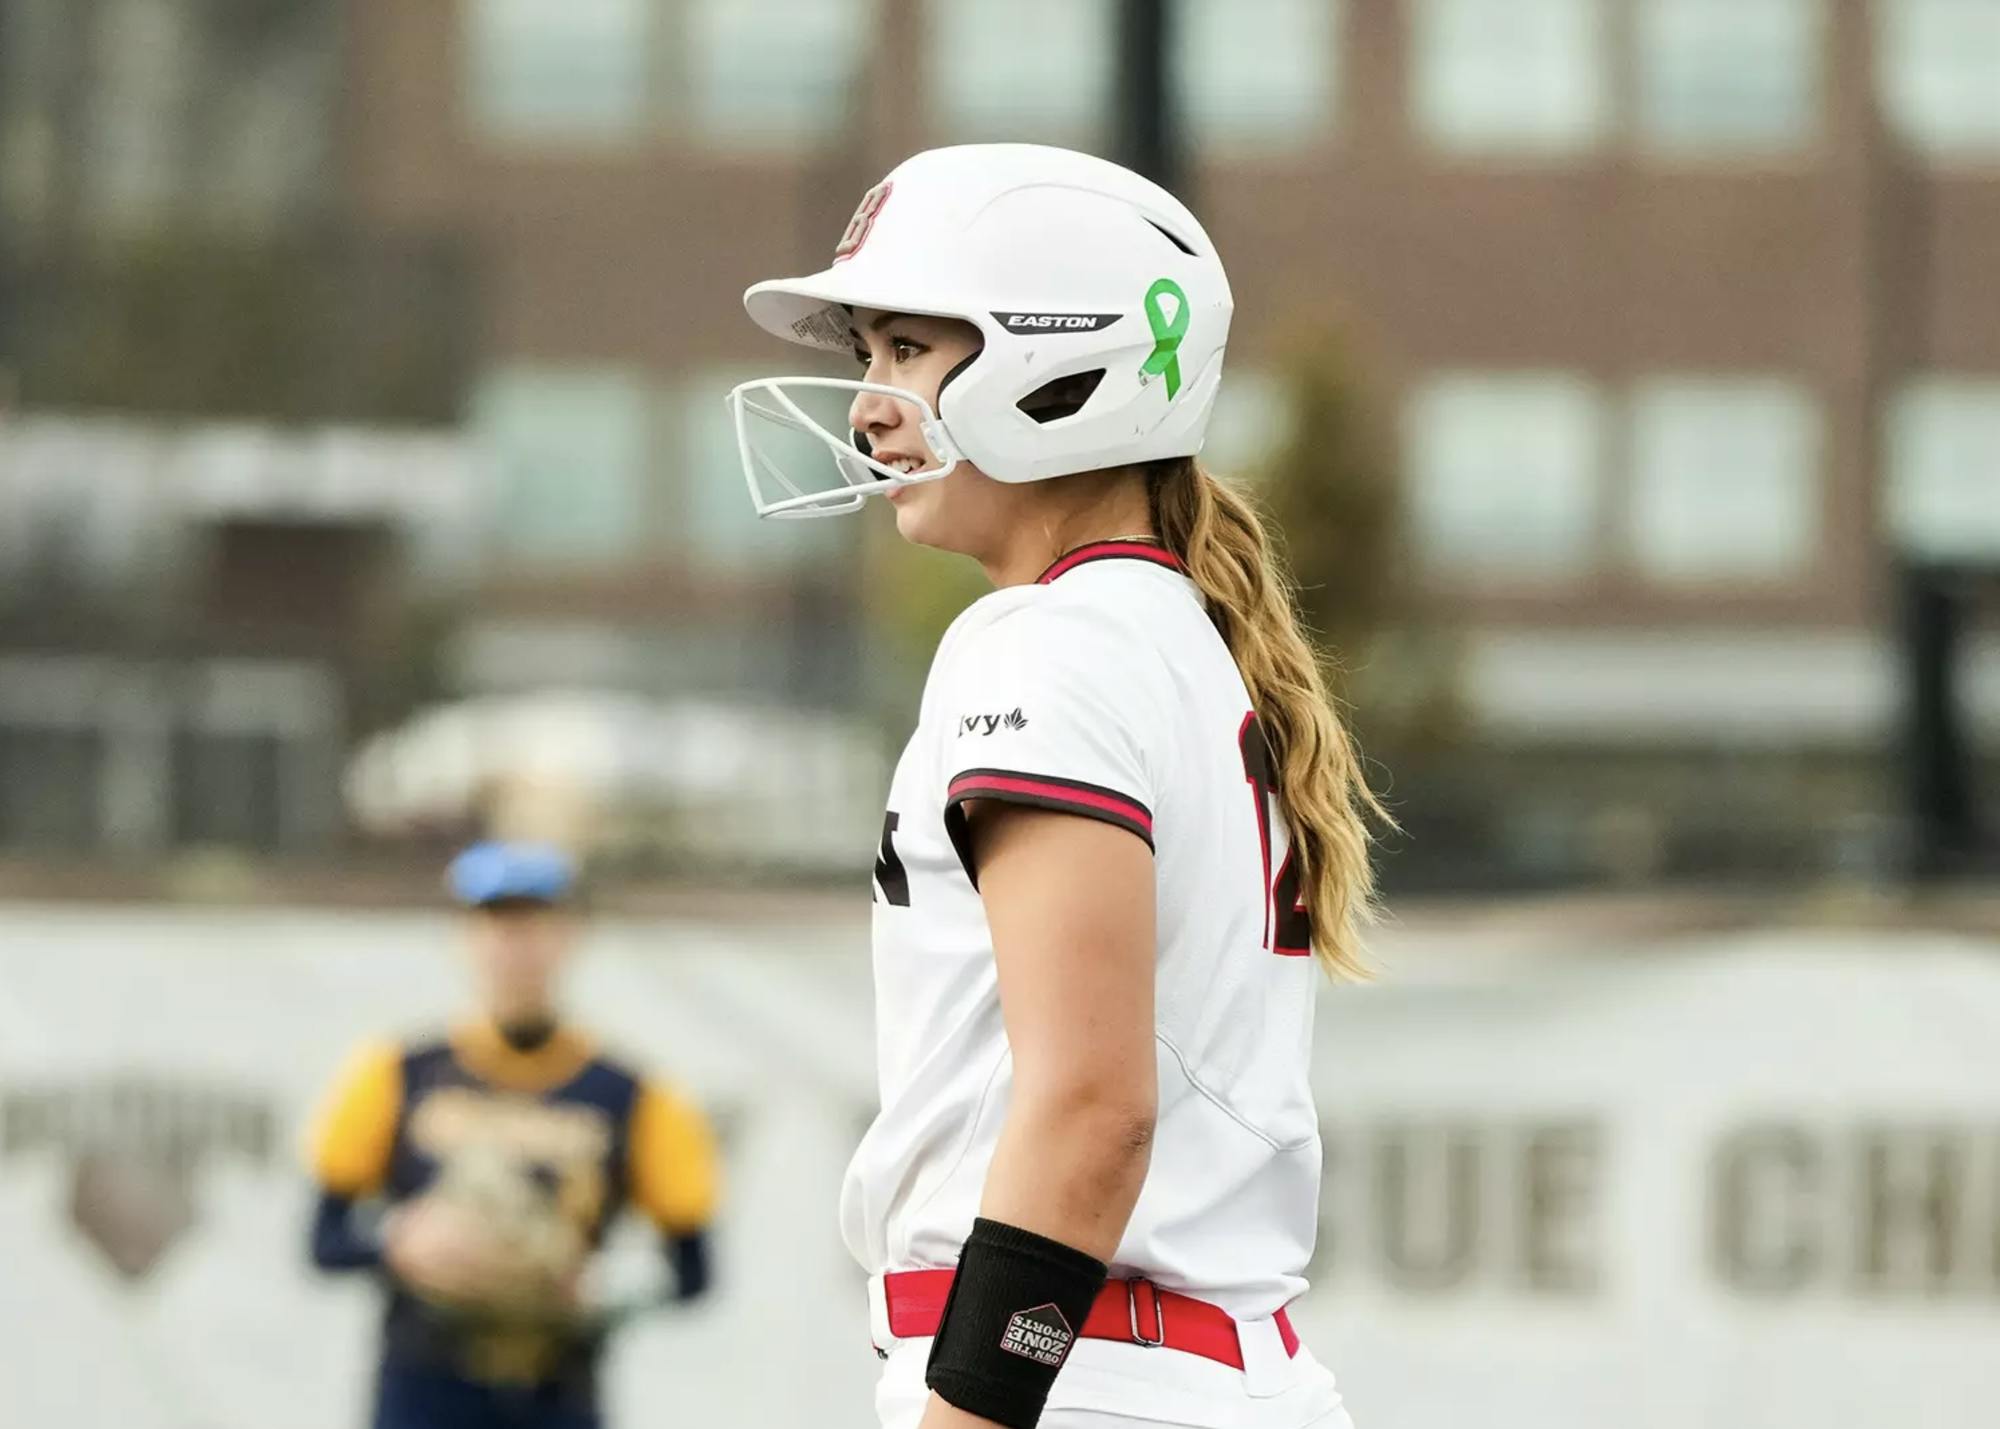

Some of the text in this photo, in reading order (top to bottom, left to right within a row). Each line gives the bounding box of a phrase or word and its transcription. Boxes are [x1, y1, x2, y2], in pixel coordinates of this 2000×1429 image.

[834, 181, 894, 266] B
[1007, 315, 1098, 328] EASTON
[1314, 1115, 2000, 1297] UE CH
[1007, 1325, 1066, 1356] ZONE
[1012, 1315, 1071, 1342] SPORTS
[1003, 1339, 1060, 1364] OWN THE
